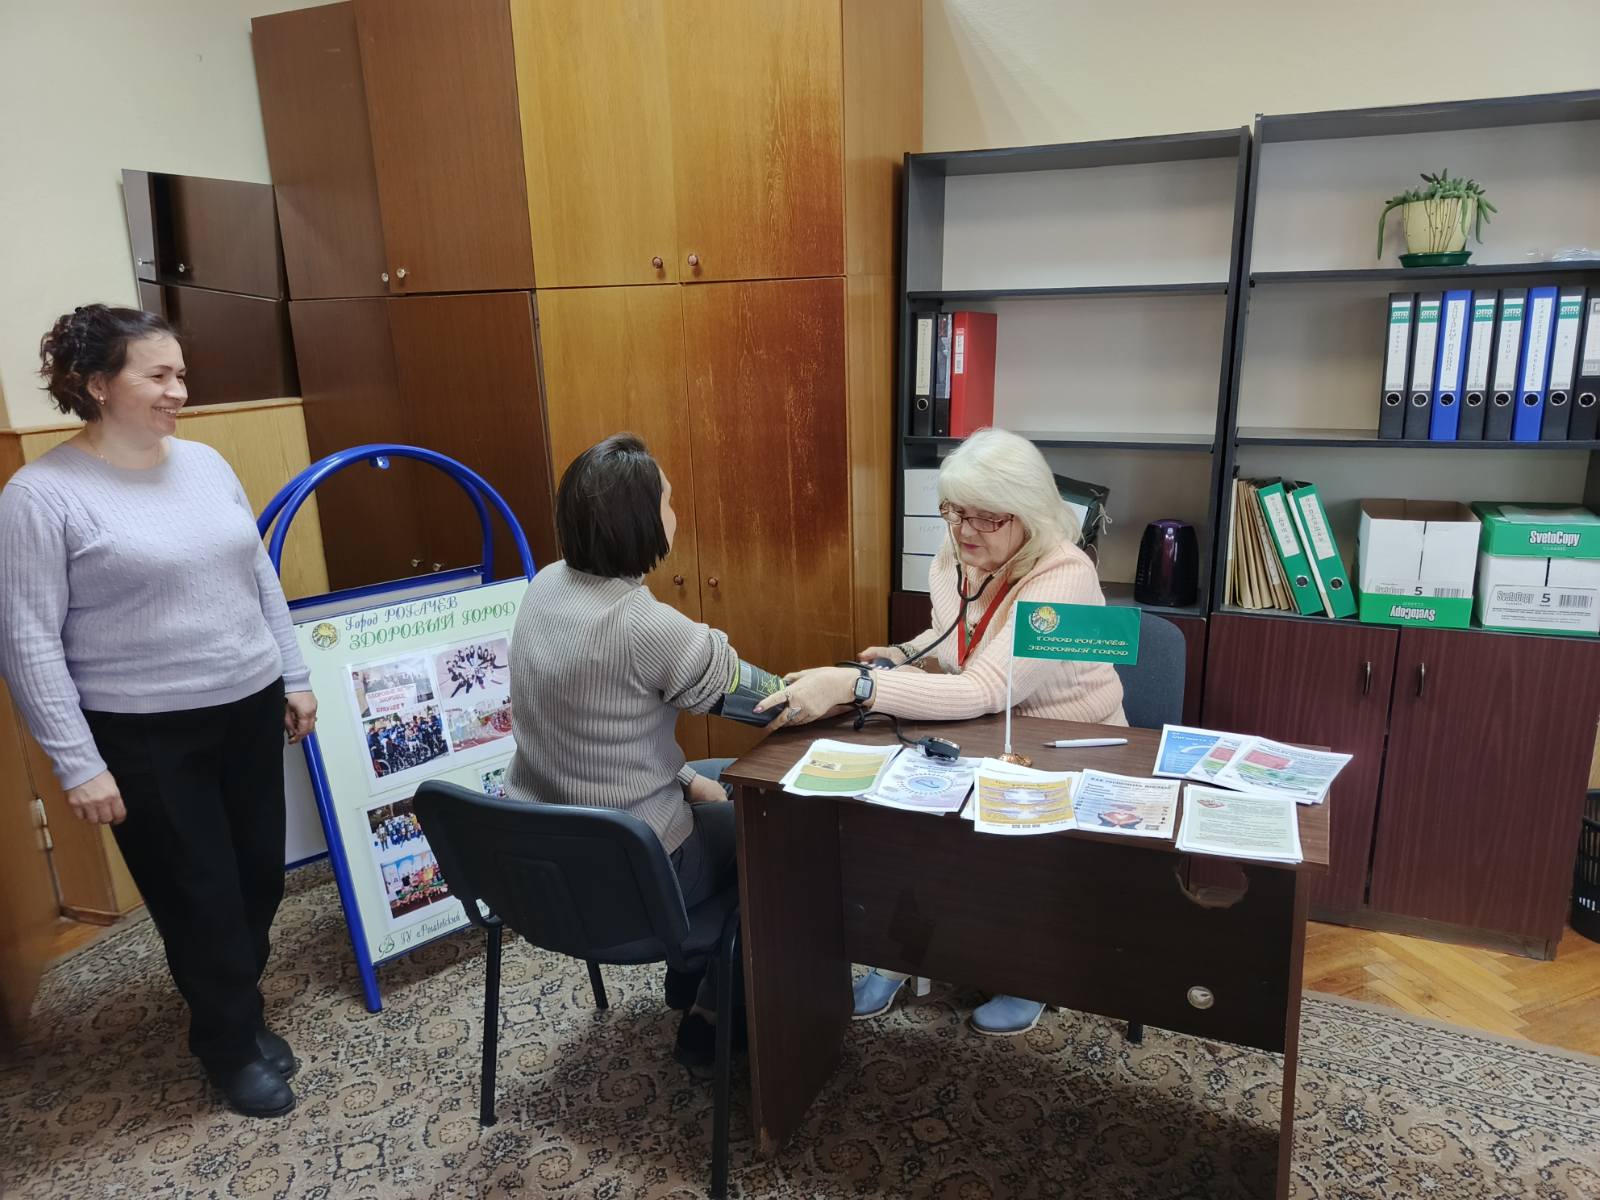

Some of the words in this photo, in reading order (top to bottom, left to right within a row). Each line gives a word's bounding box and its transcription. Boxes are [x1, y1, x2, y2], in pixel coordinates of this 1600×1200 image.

[1529, 530, 1580, 547] SvetoCopy
[1414, 586, 1423, 596] 5
[1541, 593, 1551, 603] 5
[1390, 605, 1436, 621] SvetoCopy
[345, 612, 378, 632] Город
[349, 612, 455, 650] ЗДОРОВЫЙ
[462, 601, 516, 626] ГОРОД
[1093, 648, 1129, 656] ГОРОД
